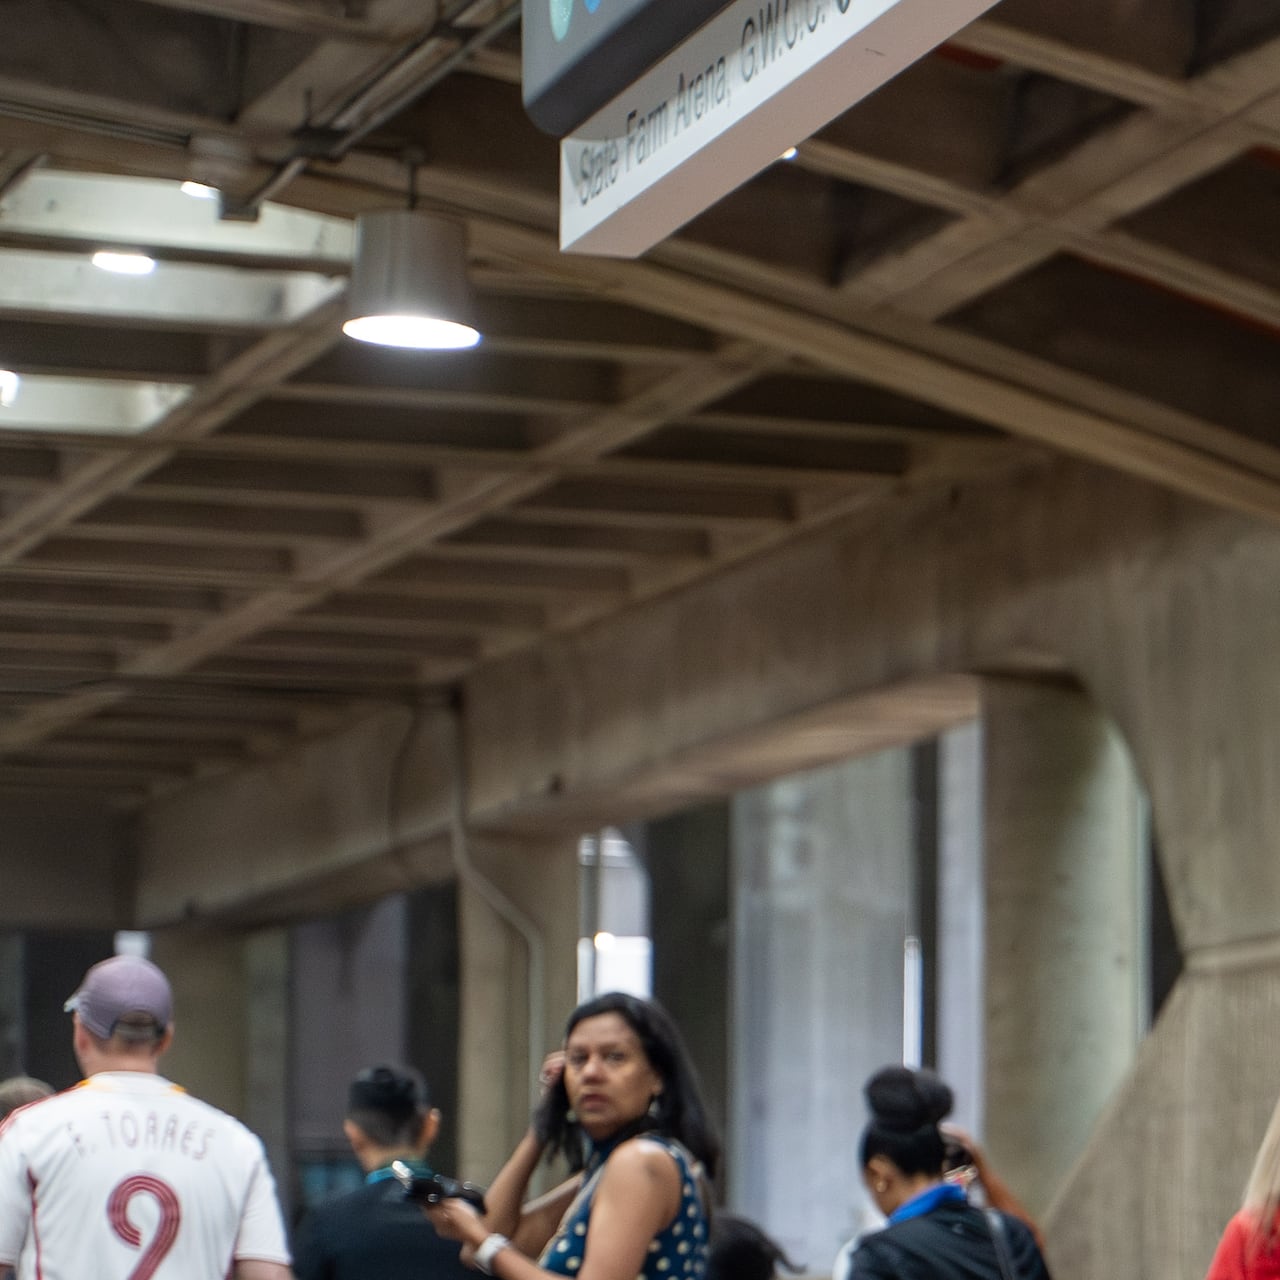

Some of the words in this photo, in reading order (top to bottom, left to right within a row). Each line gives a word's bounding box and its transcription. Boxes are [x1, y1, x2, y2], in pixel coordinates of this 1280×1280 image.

[580, 138, 619, 206] State
[625, 109, 669, 173] Farm
[673, 55, 731, 136] Arena,
